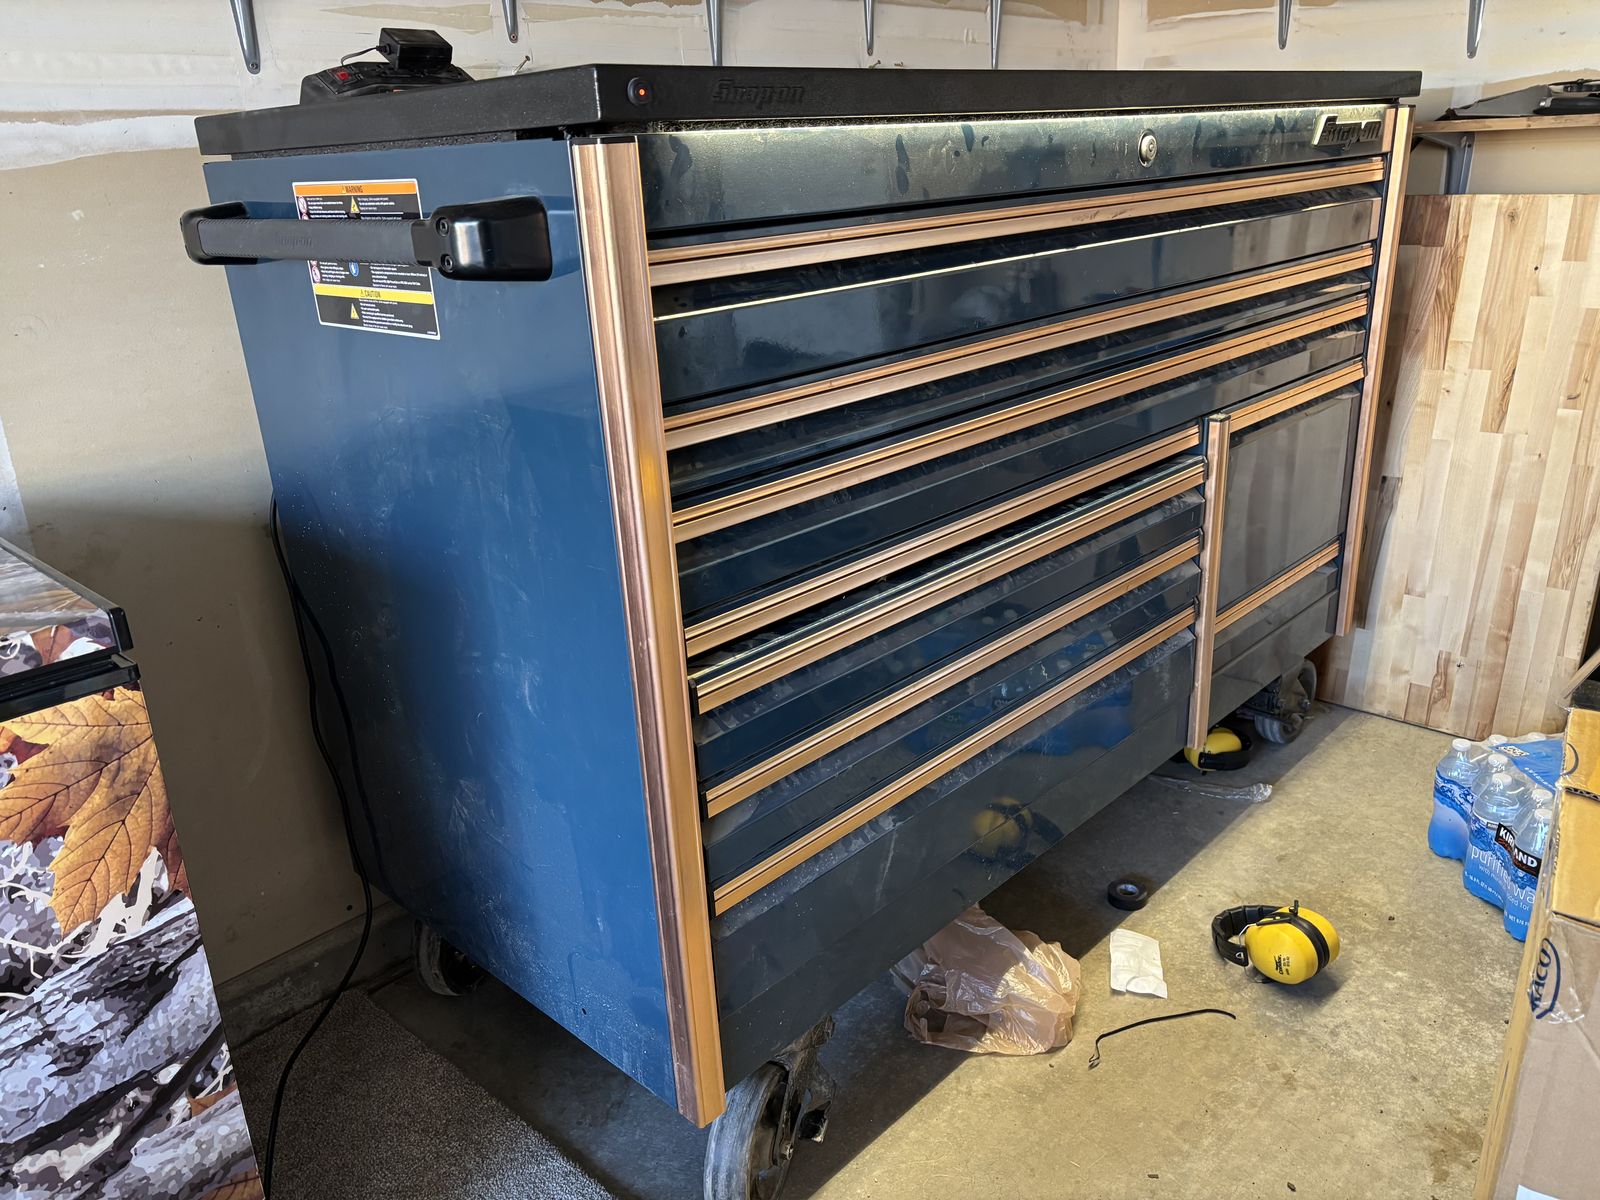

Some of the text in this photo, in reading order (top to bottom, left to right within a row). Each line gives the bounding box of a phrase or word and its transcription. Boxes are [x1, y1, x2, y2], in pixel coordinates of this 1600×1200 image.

[346, 185, 364, 194] WARNING
[364, 289, 382, 298] CAUTION
[1500, 826, 1538, 868] KIRAND
